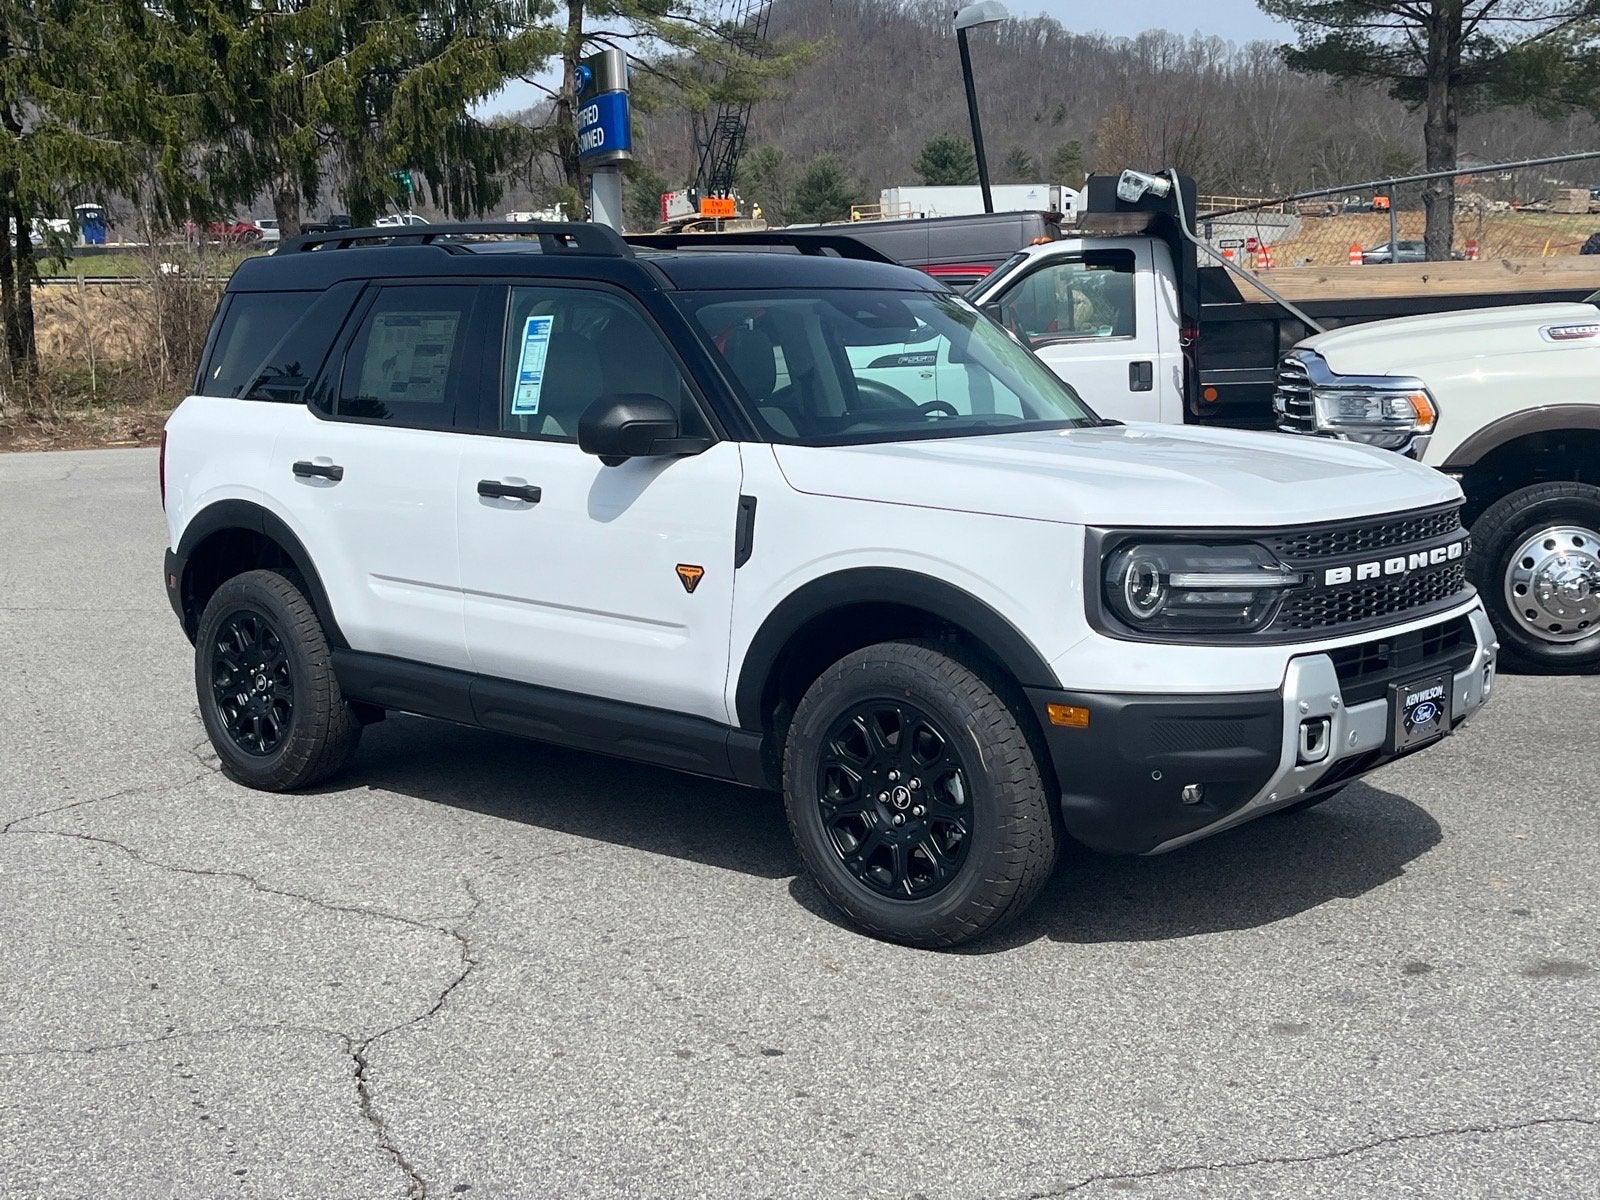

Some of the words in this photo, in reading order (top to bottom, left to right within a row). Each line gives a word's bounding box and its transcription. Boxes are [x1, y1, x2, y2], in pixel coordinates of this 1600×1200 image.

[1325, 542, 1462, 586] BRONCO
[1405, 692, 1420, 706] KEN
[1419, 685, 1443, 702] WILSON
[1416, 705, 1433, 722] Ford
